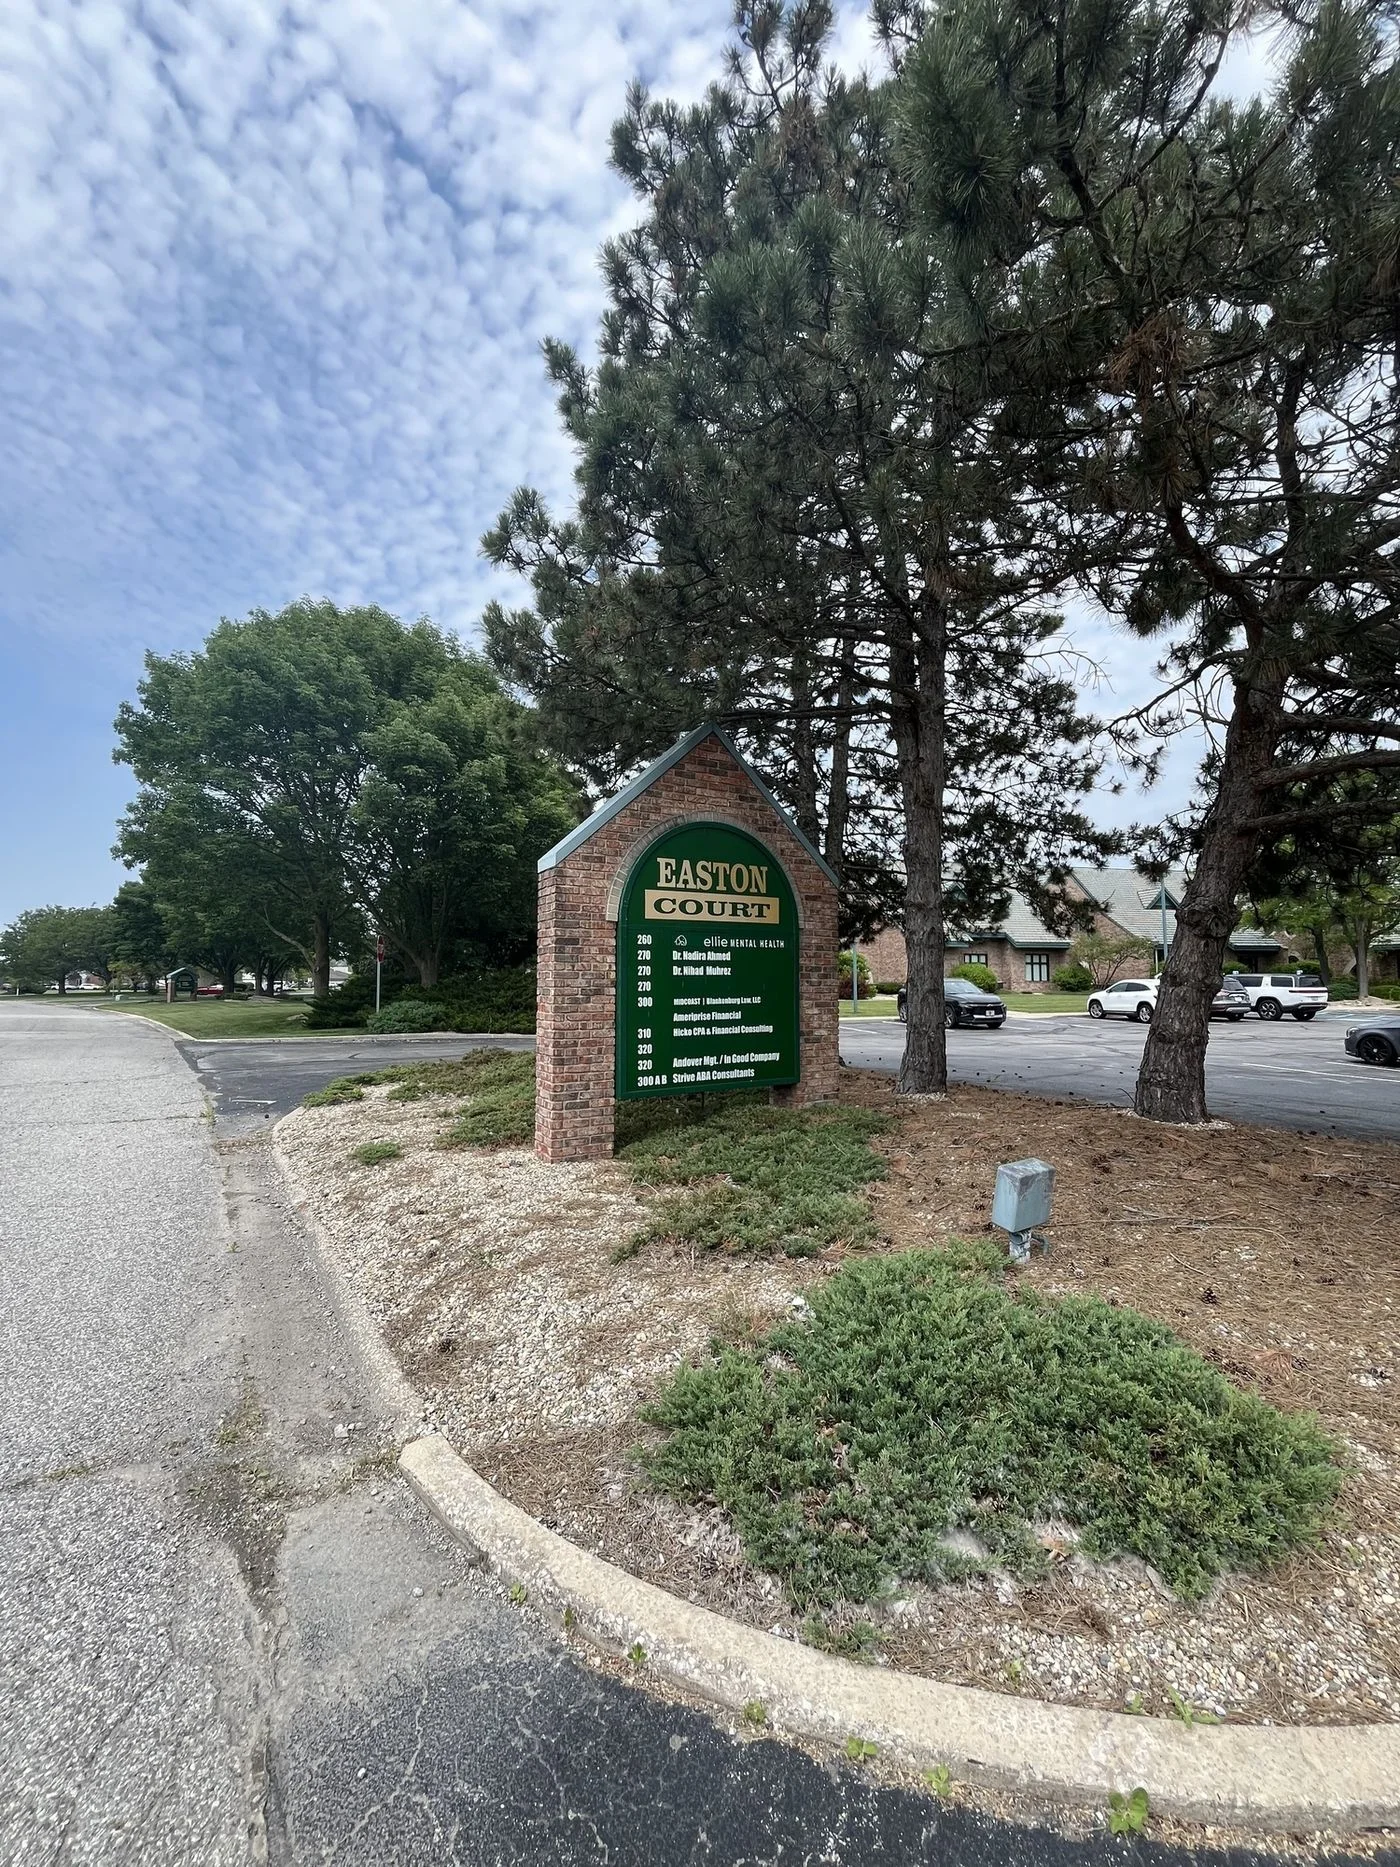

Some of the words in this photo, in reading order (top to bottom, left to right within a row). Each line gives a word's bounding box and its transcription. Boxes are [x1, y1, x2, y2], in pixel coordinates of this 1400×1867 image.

[657, 857, 768, 894] EASTON
[653, 898, 770, 918] COURT
[637, 934, 652, 945] 260
[704, 936, 728, 947] ellie
[730, 939, 756, 948] MENTAL
[760, 940, 785, 948] HEALTH
[637, 950, 651, 960] 270
[673, 950, 682, 960] Dr.
[683, 951, 706, 961] Nadira
[707, 951, 731, 961] Ahmed
[637, 965, 651, 976] 270
[673, 966, 682, 976] Dr.
[683, 966, 704, 976] Nihad
[637, 981, 651, 992] 270
[637, 996, 653, 1007] 300
[673, 1012, 711, 1022] Ameriprise
[712, 1011, 741, 1021] Financial
[637, 1028, 651, 1039] 310
[693, 1027, 705, 1035] CPA
[712, 1026, 740, 1035] Financial
[741, 1024, 773, 1034] Consulting
[637, 1044, 653, 1055] 320
[637, 1059, 653, 1071] 320
[673, 1057, 702, 1068] Andover
[703, 1056, 719, 1066] Mgt.
[724, 1054, 731, 1064] In
[732, 1053, 749, 1063] Good
[750, 1052, 780, 1061] Company
[637, 1076, 654, 1087] 300
[654, 1075, 662, 1085] A
[662, 1075, 667, 1085] B
[672, 1073, 695, 1083] Strive
[696, 1071, 711, 1081] ABA
[712, 1069, 755, 1080] Consultants
